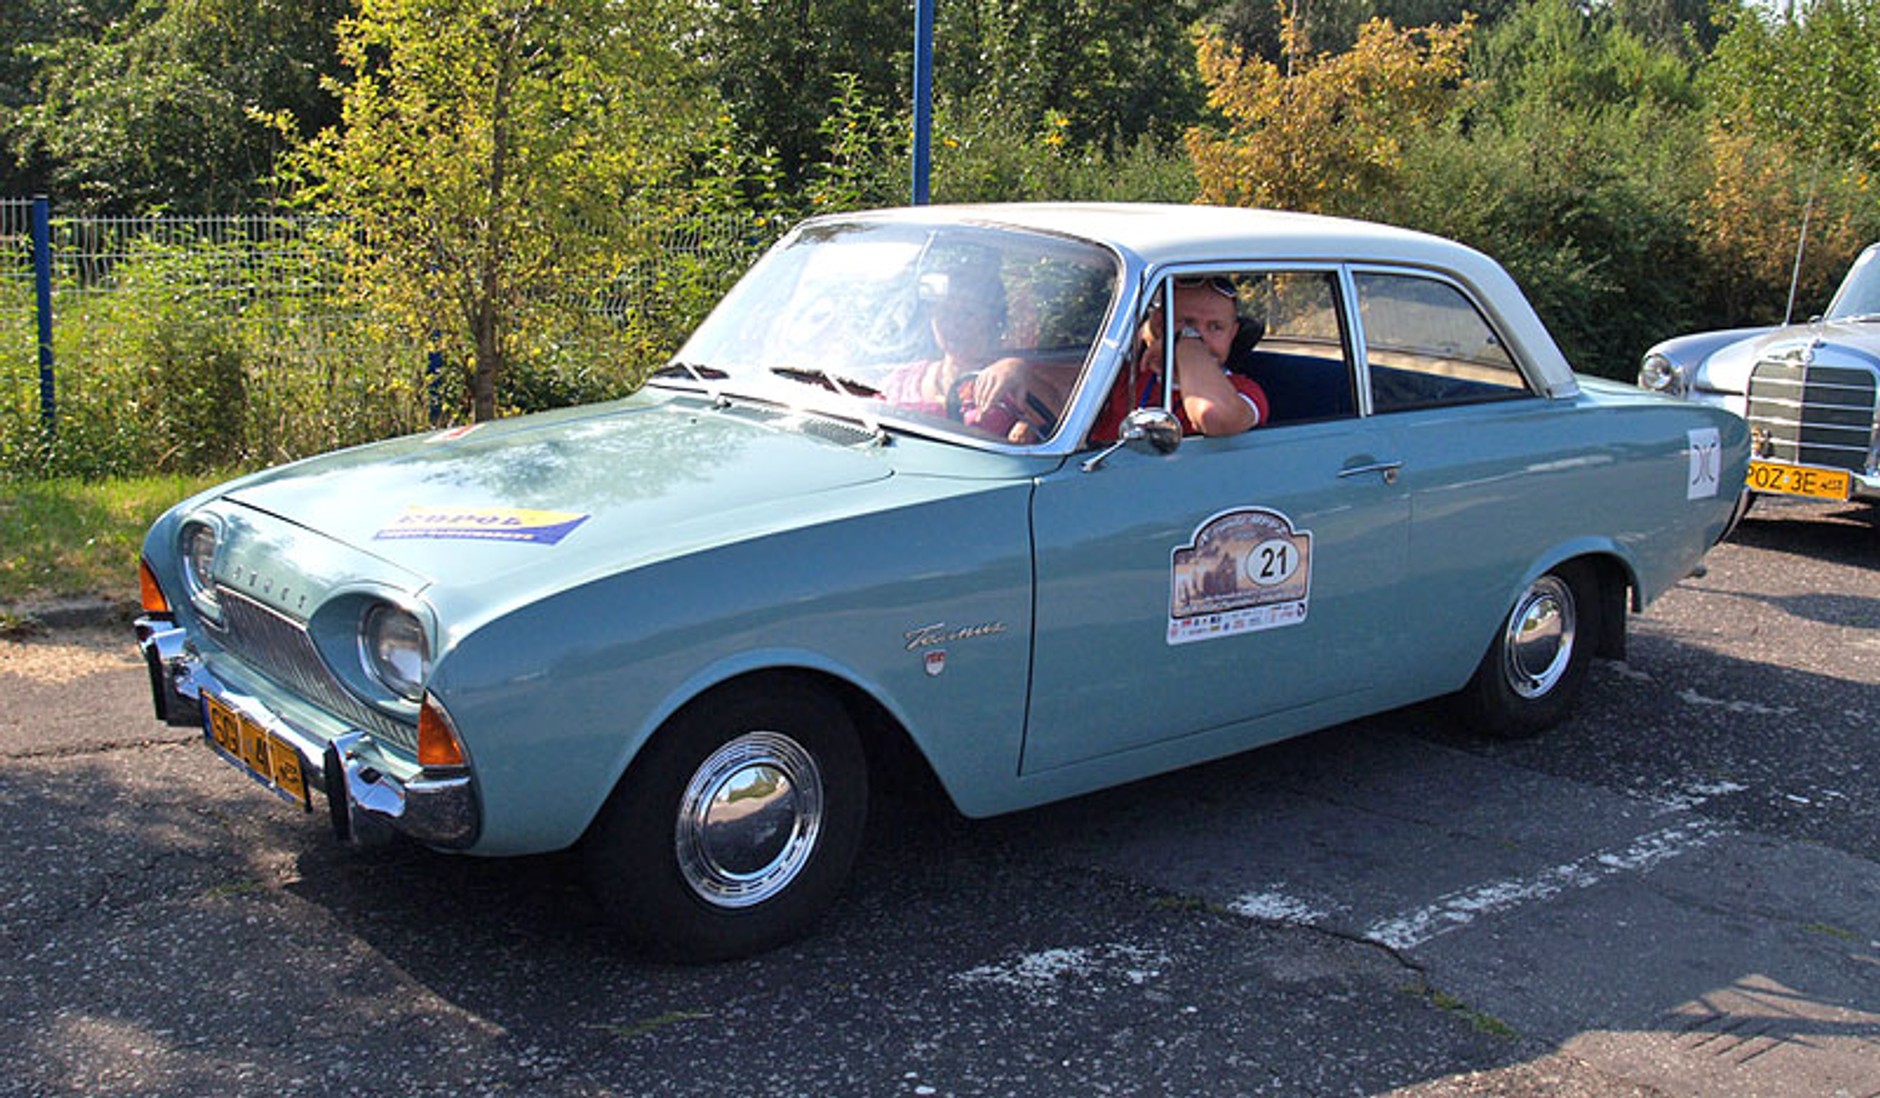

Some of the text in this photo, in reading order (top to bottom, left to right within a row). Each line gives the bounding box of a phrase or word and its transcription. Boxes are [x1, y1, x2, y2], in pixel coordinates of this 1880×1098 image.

[1790, 470, 1817, 494] 3E
[1260, 545, 1288, 578] 21
[904, 622, 1007, 651] Taunus
